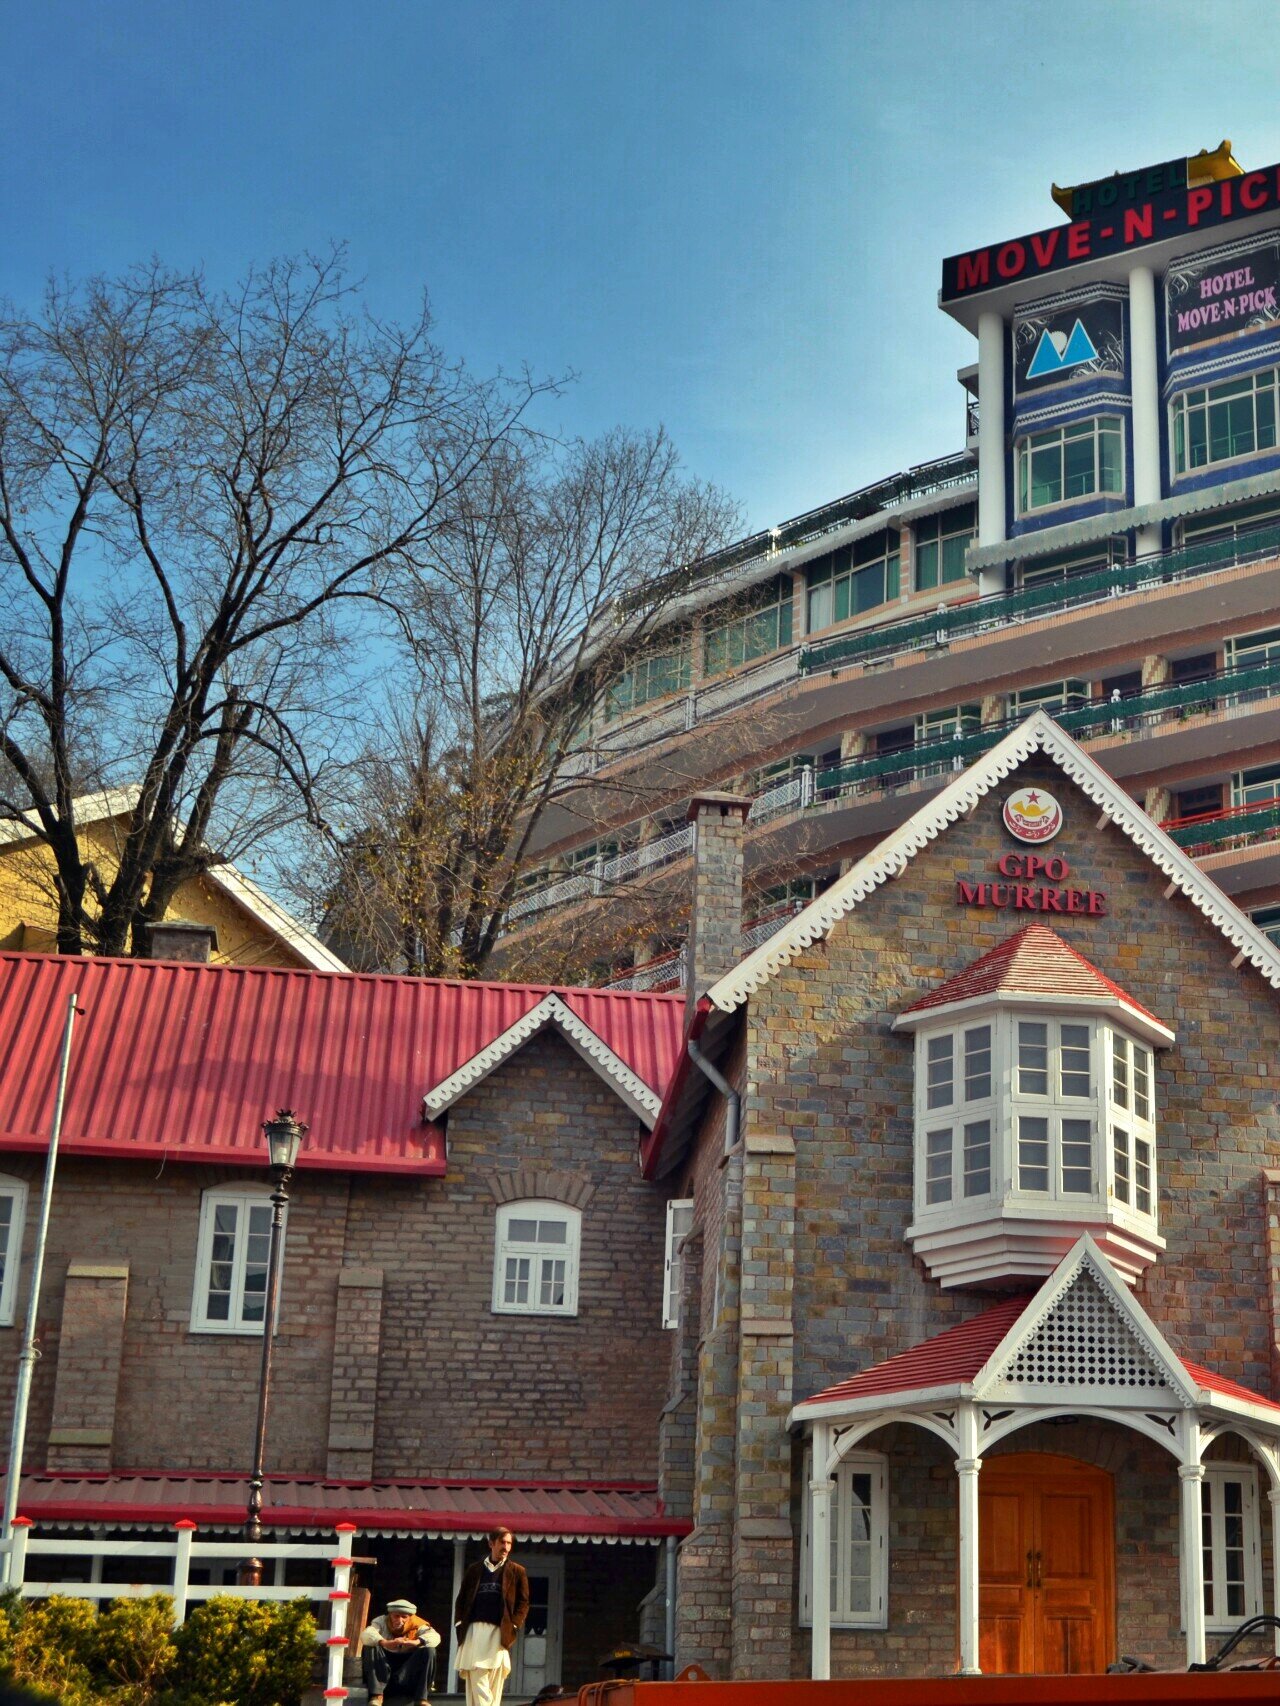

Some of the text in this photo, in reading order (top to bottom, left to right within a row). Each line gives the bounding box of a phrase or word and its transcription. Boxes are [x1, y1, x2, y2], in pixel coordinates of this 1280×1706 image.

[1072, 163, 1188, 216] HOTEL
[1199, 266, 1255, 299] HOTEL
[998, 852, 1070, 881] GPO
[956, 880, 1108, 917] MURREE
